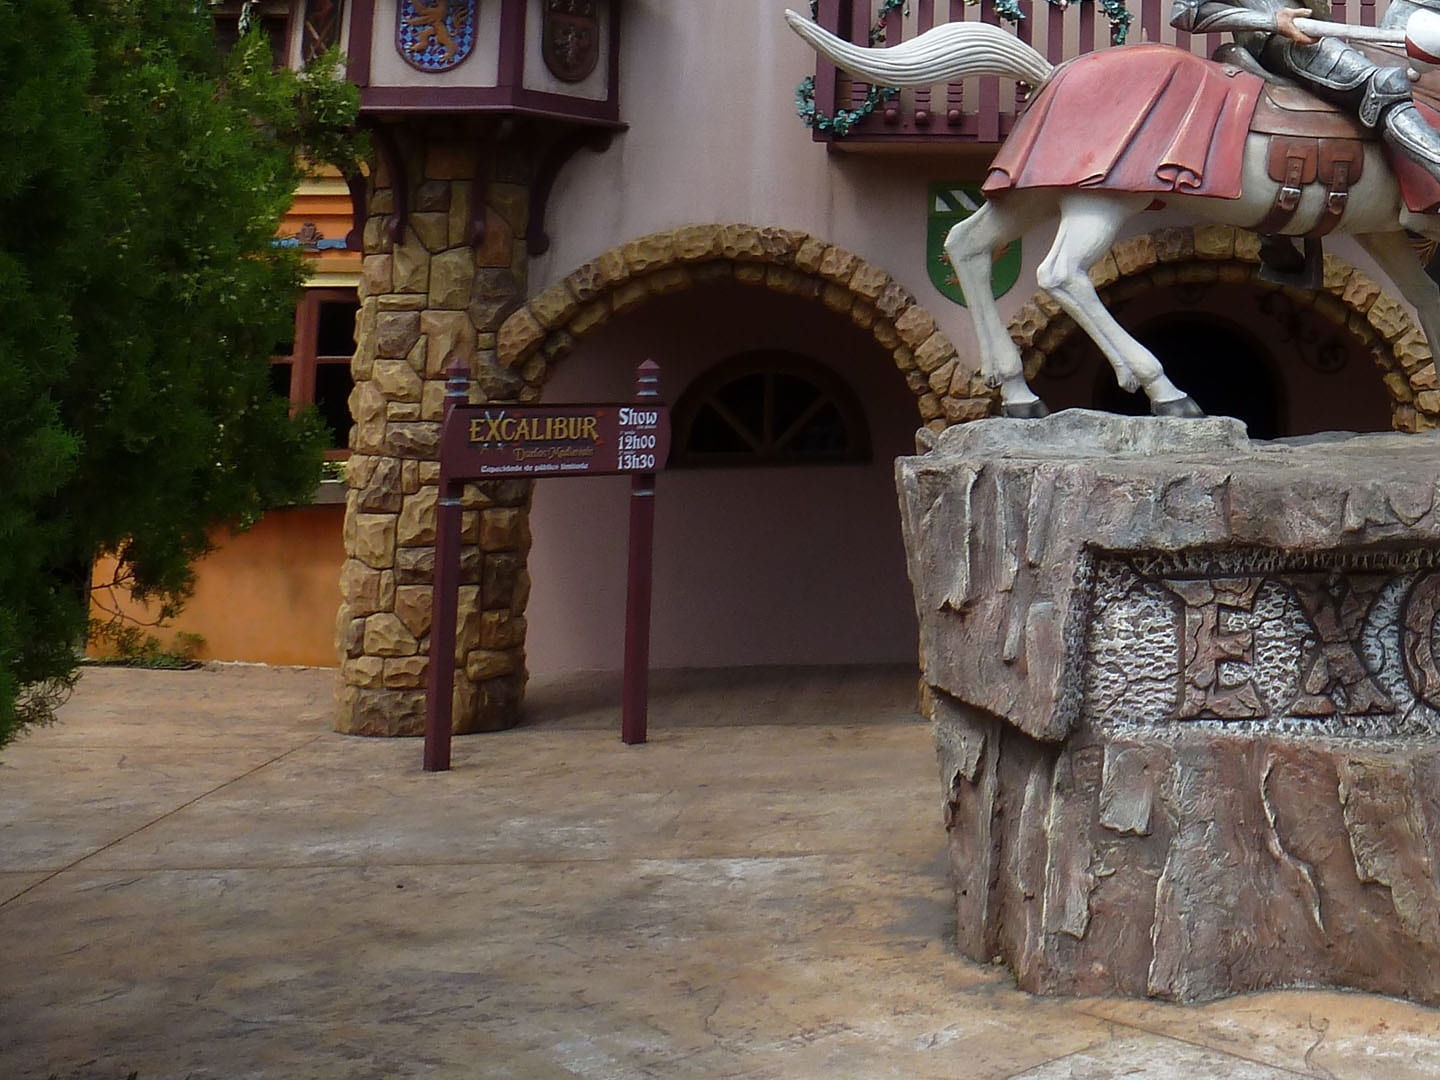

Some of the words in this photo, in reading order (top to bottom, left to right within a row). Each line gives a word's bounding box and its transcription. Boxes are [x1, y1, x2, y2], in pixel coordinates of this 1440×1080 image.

[618, 407, 658, 425] Show
[470, 416, 600, 441] EXCALIBUR
[618, 435, 656, 450] 12h00
[617, 454, 656, 470] 13h30
